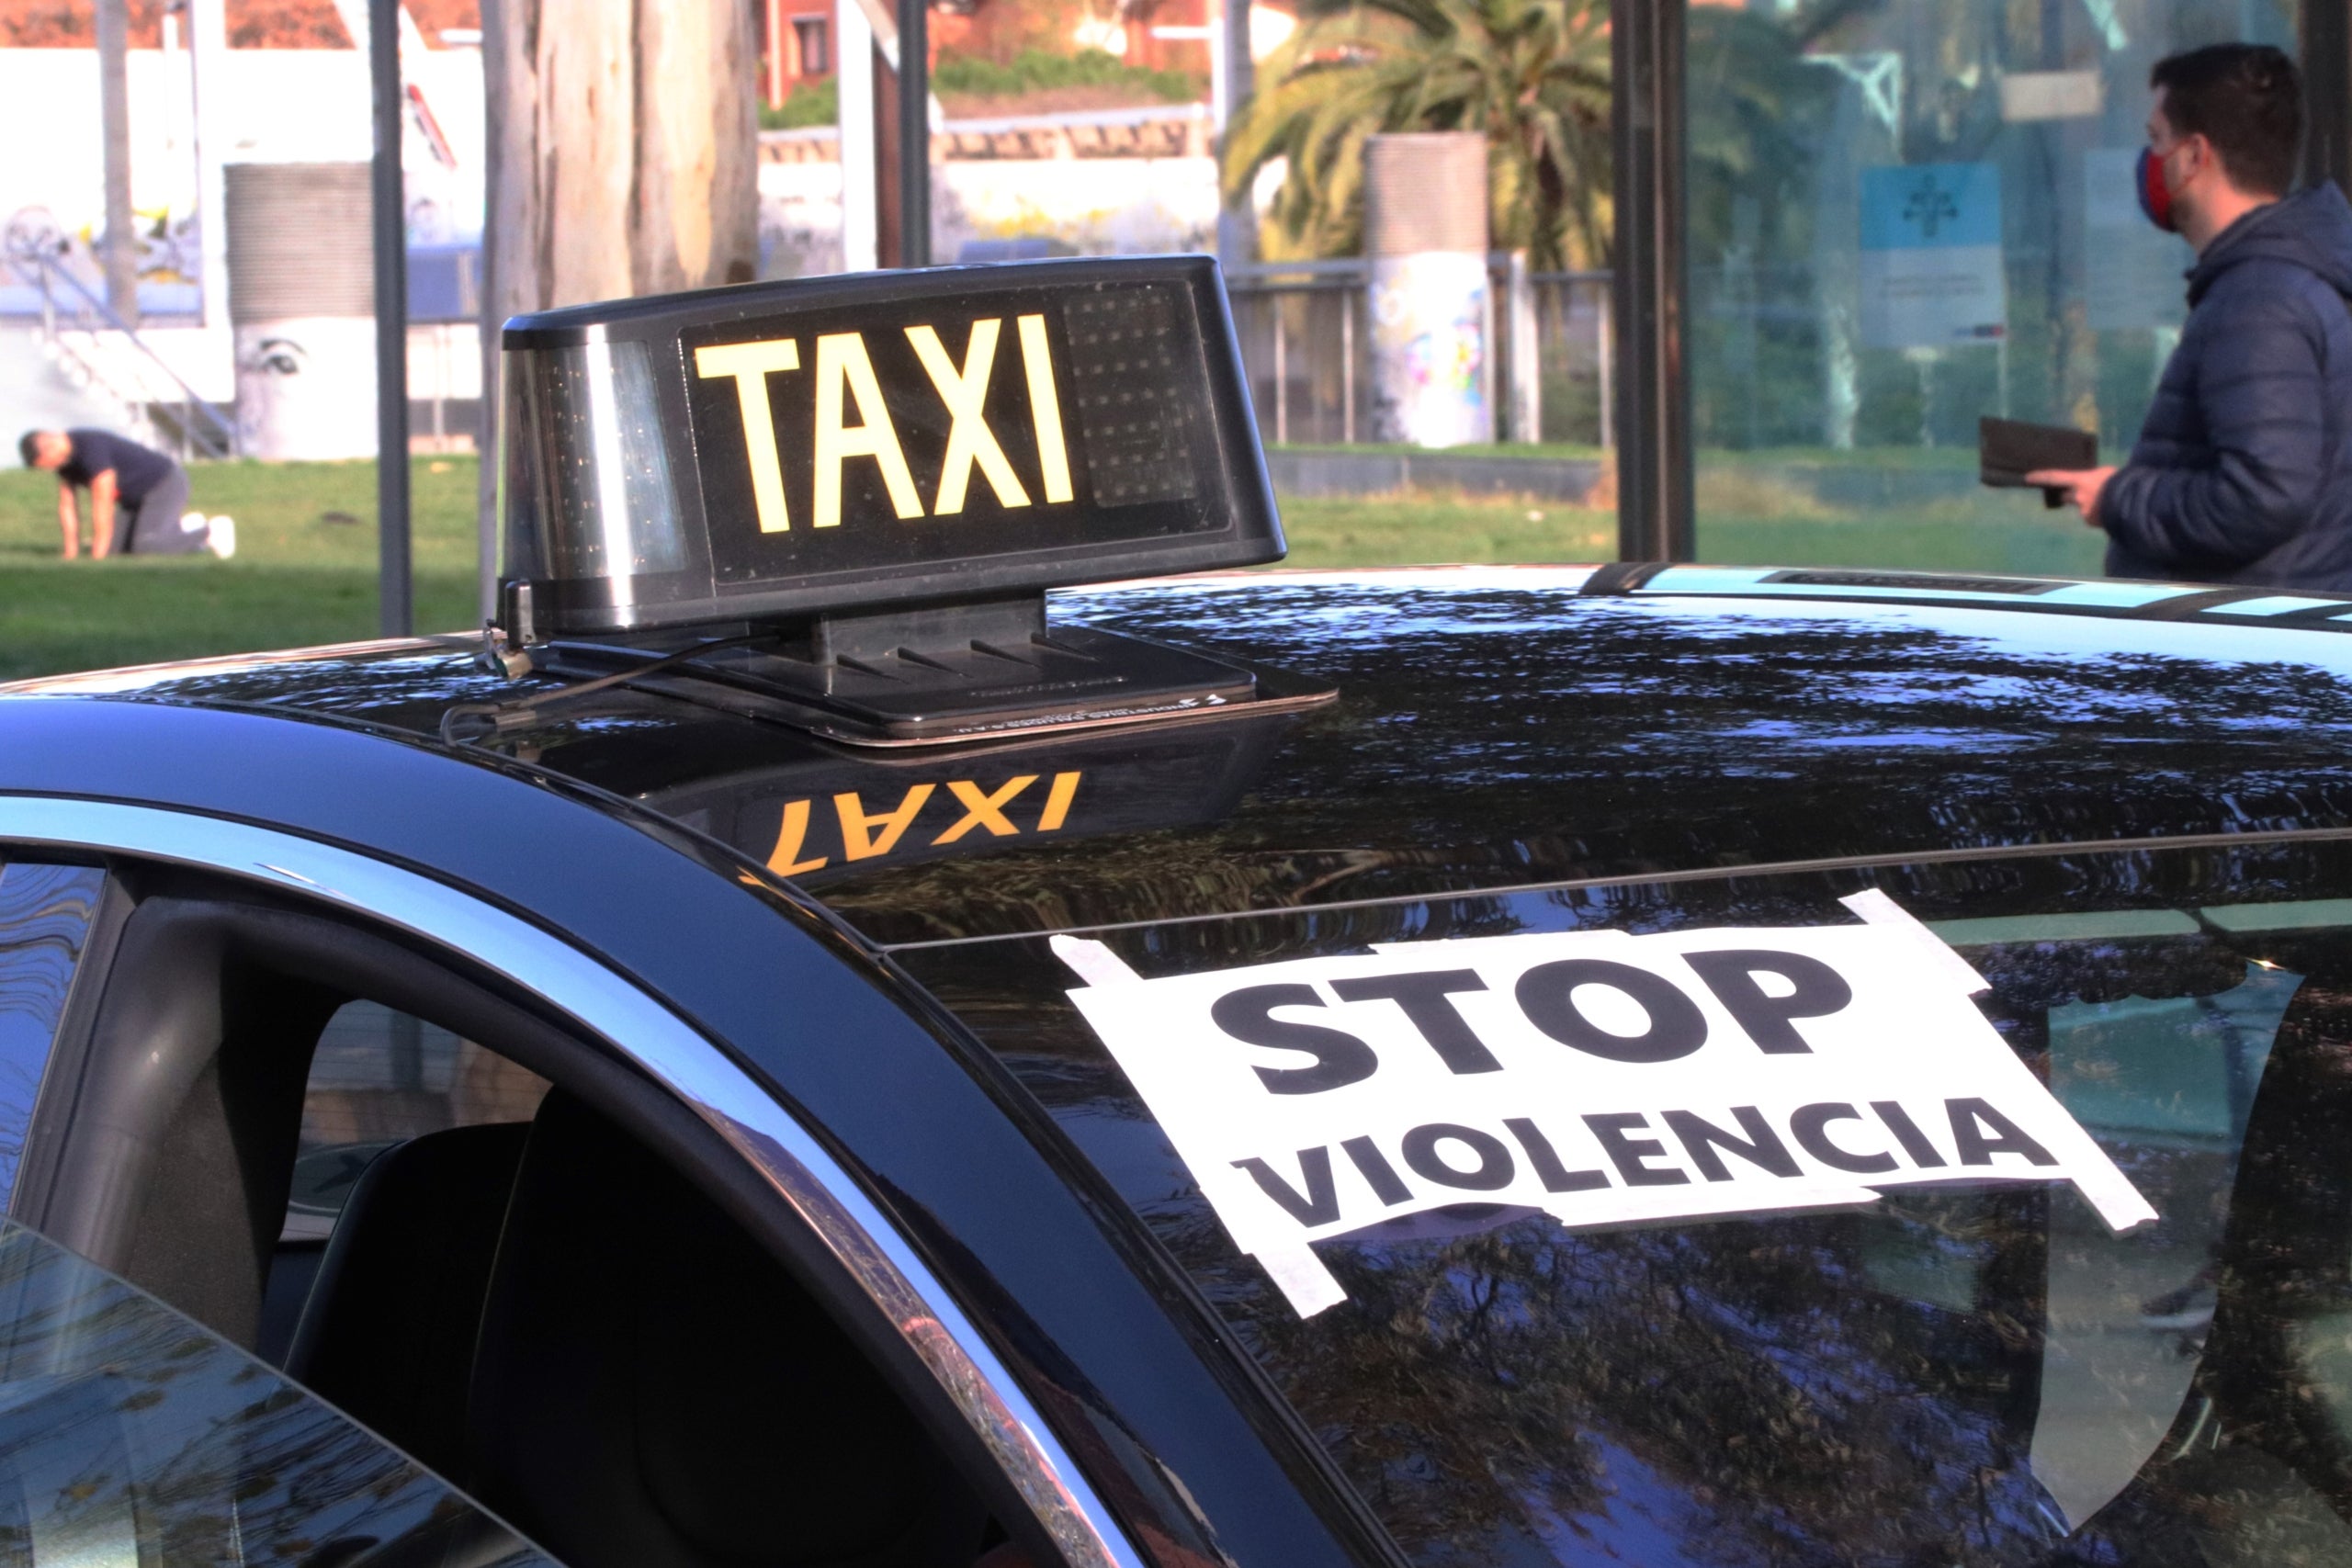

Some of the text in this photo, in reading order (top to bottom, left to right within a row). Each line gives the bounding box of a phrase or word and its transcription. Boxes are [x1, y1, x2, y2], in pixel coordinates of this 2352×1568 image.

[695, 314, 1074, 534] TAXI
[1211, 949, 1852, 1095] STOP
[1229, 1097, 2059, 1228] VIOLENCIA
